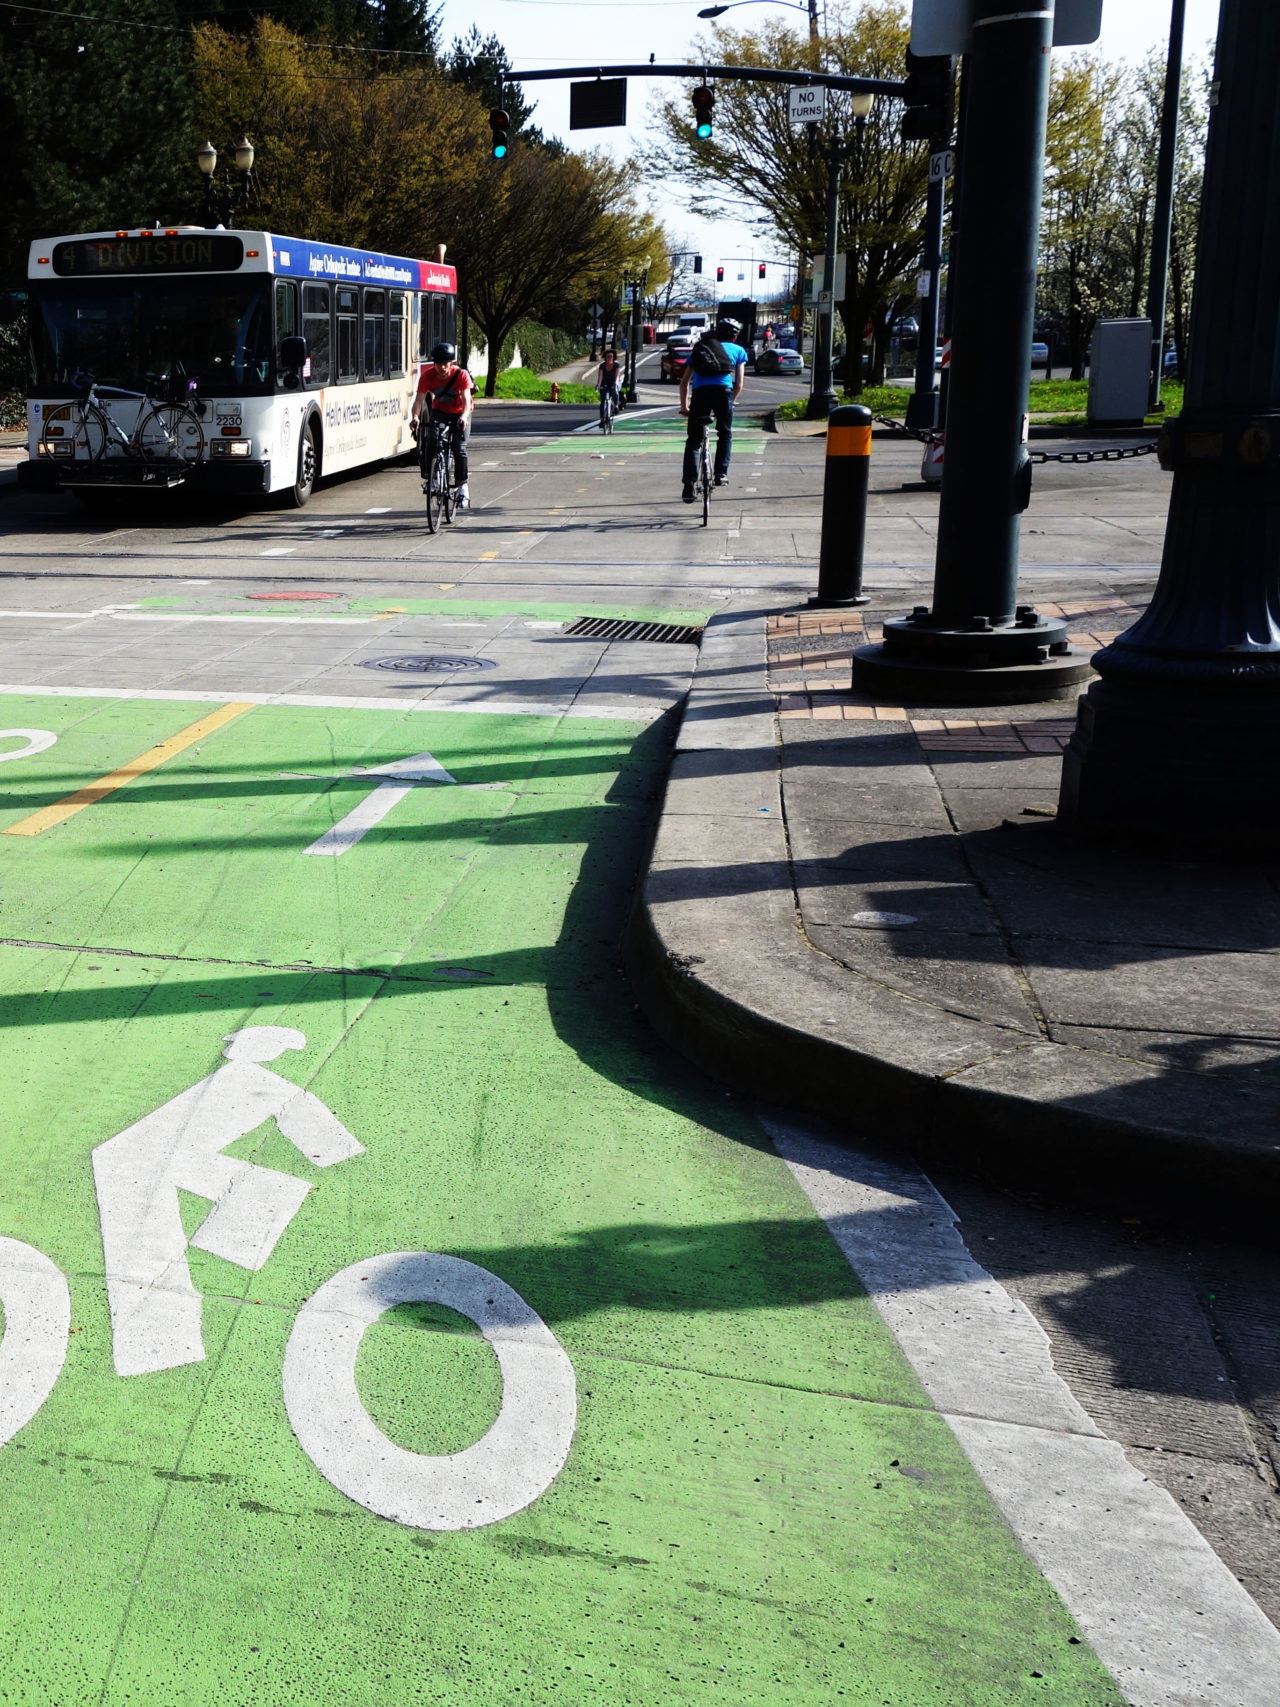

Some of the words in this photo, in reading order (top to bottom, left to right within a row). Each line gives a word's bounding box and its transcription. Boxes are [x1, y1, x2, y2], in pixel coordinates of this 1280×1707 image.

[799, 92, 815, 103] NO
[791, 106, 822, 117] TURNS
[931, 157, 941, 175] 16
[944, 154, 952, 173] C
[62, 244, 77, 270] 4
[97, 239, 214, 268] DIVISION
[325, 401, 342, 428] Hello
[363, 396, 389, 420] Welcome
[216, 416, 243, 426] 2230
